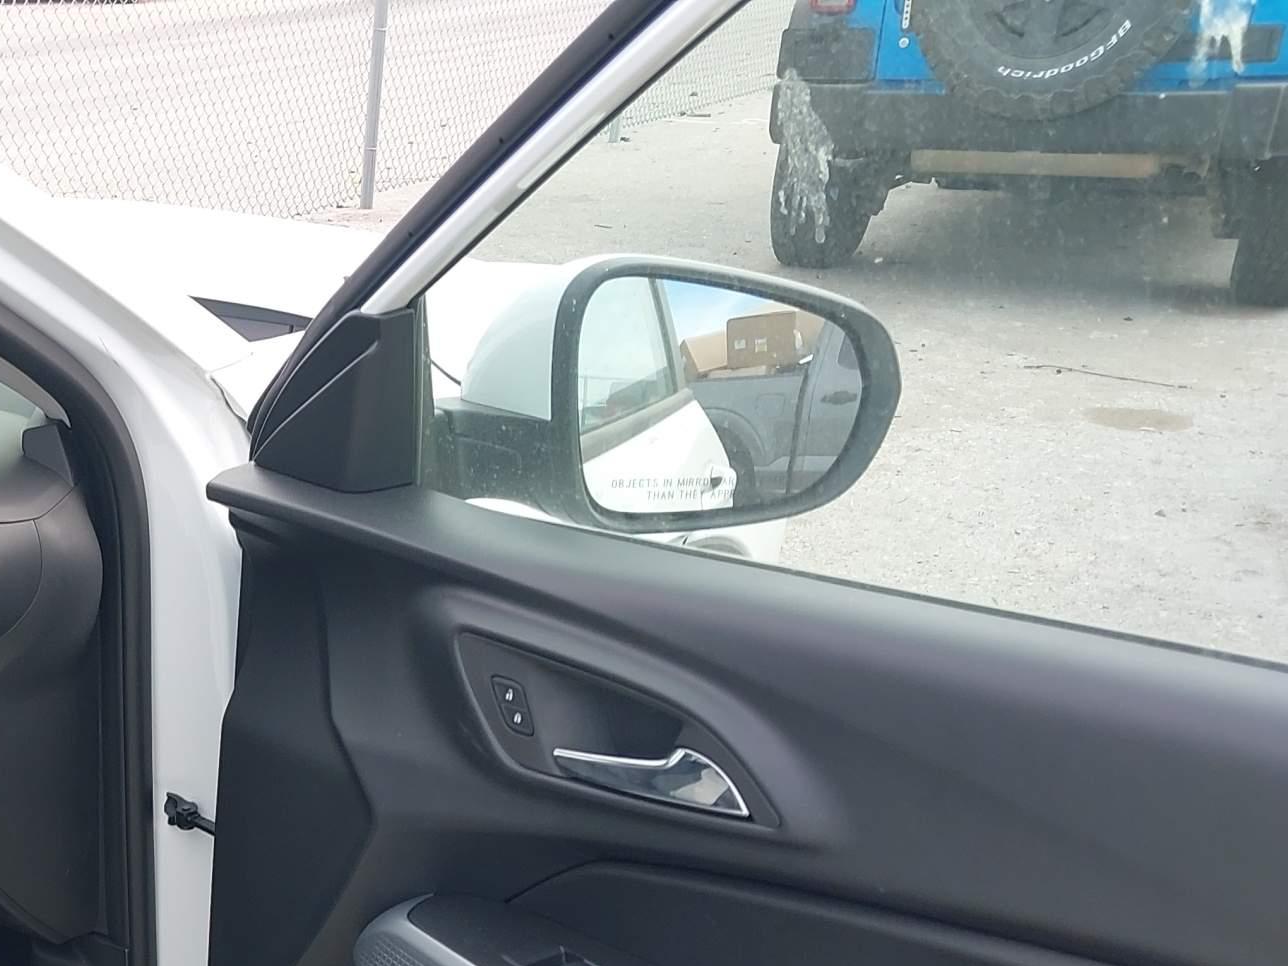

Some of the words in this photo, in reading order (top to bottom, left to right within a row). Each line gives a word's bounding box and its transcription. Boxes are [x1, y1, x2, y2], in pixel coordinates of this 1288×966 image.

[997, 19, 1132, 80] BFGoodrich
[611, 477, 658, 488] OBJECTS
[663, 477, 673, 488] IN
[676, 477, 711, 488] MIRRO
[647, 489, 675, 500] THAN
[679, 489, 705, 500] THEY
